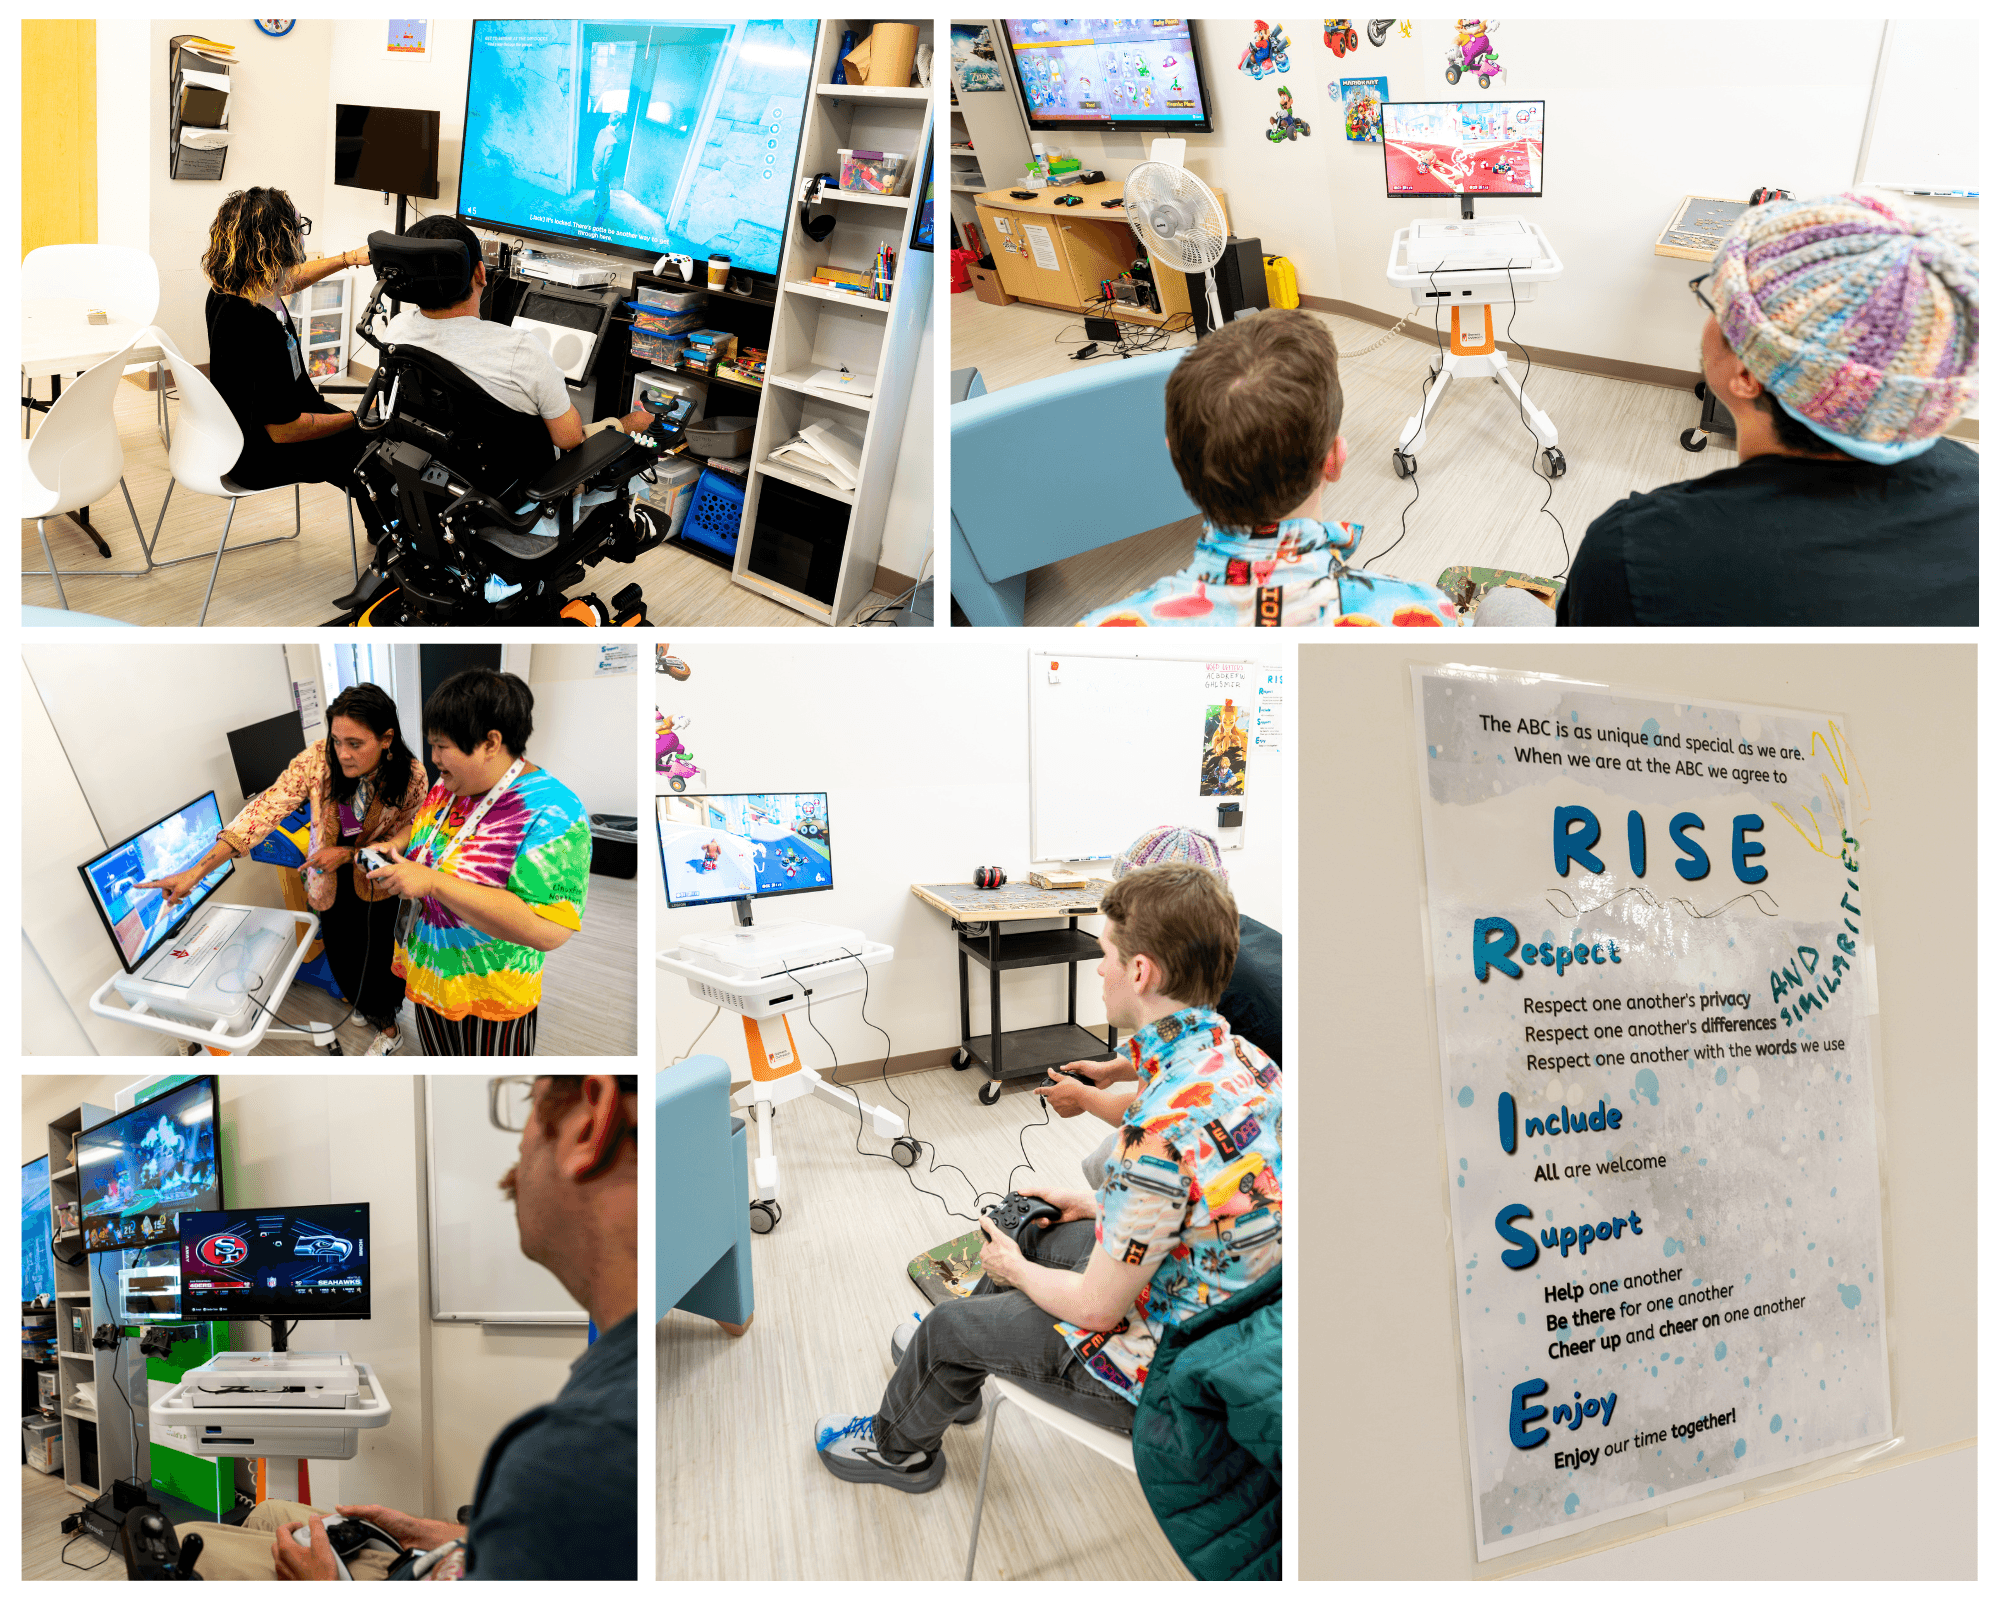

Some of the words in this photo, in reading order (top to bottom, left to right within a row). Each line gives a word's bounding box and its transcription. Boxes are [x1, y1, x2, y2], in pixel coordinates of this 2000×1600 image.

[573, 221, 592, 231] There's
[592, 225, 607, 234] gotta
[608, 227, 616, 235] be
[616, 230, 638, 239] another
[639, 233, 651, 243] way
[652, 235, 658, 243] to
[659, 237, 670, 245] get
[577, 230, 599, 239] through
[600, 233, 613, 242] here.
[1479, 714, 1511, 733] The
[1517, 718, 1551, 736] ABC
[1556, 721, 1569, 738] is
[1574, 726, 1592, 740] as
[1597, 727, 1649, 748] unique
[1653, 733, 1681, 749] and
[1686, 737, 1735, 754] special
[1738, 743, 1754, 756] as
[1757, 745, 1776, 758] we
[1780, 748, 1805, 761] are.
[1514, 746, 1562, 765] When
[1568, 754, 1591, 767] we
[1595, 756, 1621, 770] are
[1626, 758, 1642, 772] at
[1646, 757, 1671, 774] the
[1675, 760, 1704, 777] ABC
[1708, 766, 1728, 779] we
[1732, 767, 1770, 784] agree
[1773, 770, 1788, 783] to
[1553, 804, 1769, 884] RISE
[1473, 917, 1621, 983] Respect
[1780, 828, 1861, 1027] SIMILARITIES
[1770, 946, 1820, 1004] AND
[1523, 997, 1588, 1017] Respect
[1592, 999, 1622, 1011] one
[1626, 992, 1696, 1010] another's
[1700, 991, 1751, 1011] privacy
[1525, 1025, 1589, 1045] Respect
[1594, 1026, 1623, 1039] one
[1628, 1019, 1697, 1037] another's
[1701, 1016, 1777, 1033] differences
[1527, 1053, 1591, 1073] Respect
[1595, 1053, 1625, 1066] one
[1630, 1046, 1688, 1064] another
[1694, 1043, 1725, 1060] with
[1728, 1042, 1752, 1057] the
[1755, 1039, 1797, 1056] words
[1801, 1042, 1819, 1053] we
[1823, 1039, 1845, 1051] use
[1498, 1091, 1623, 1154] Include
[1534, 1162, 1560, 1182] All
[1564, 1162, 1591, 1179] are
[1596, 1155, 1667, 1174] welcome
[214, 1238, 244, 1264] SF
[1495, 1203, 1643, 1271] Support
[1544, 1283, 1585, 1304] Help
[1588, 1279, 1619, 1296] one
[1623, 1268, 1683, 1290] another
[1546, 1314, 1569, 1332] Be
[1572, 1306, 1616, 1328] there
[1619, 1301, 1642, 1318] for
[1646, 1298, 1674, 1313] one
[1677, 1284, 1734, 1307] another
[1548, 1339, 1597, 1360] Cheer
[1600, 1333, 1622, 1352] up
[1625, 1324, 1655, 1345] and
[1659, 1317, 1699, 1338] cheer
[1702, 1313, 1721, 1329] on
[1723, 1308, 1750, 1324] one
[1753, 1295, 1806, 1318] another
[1509, 1377, 1618, 1450] Enjoy
[1553, 1445, 1600, 1470] Enjoy
[1604, 1438, 1630, 1457] our
[1633, 1428, 1668, 1448] time
[1670, 1407, 1737, 1441] together!
